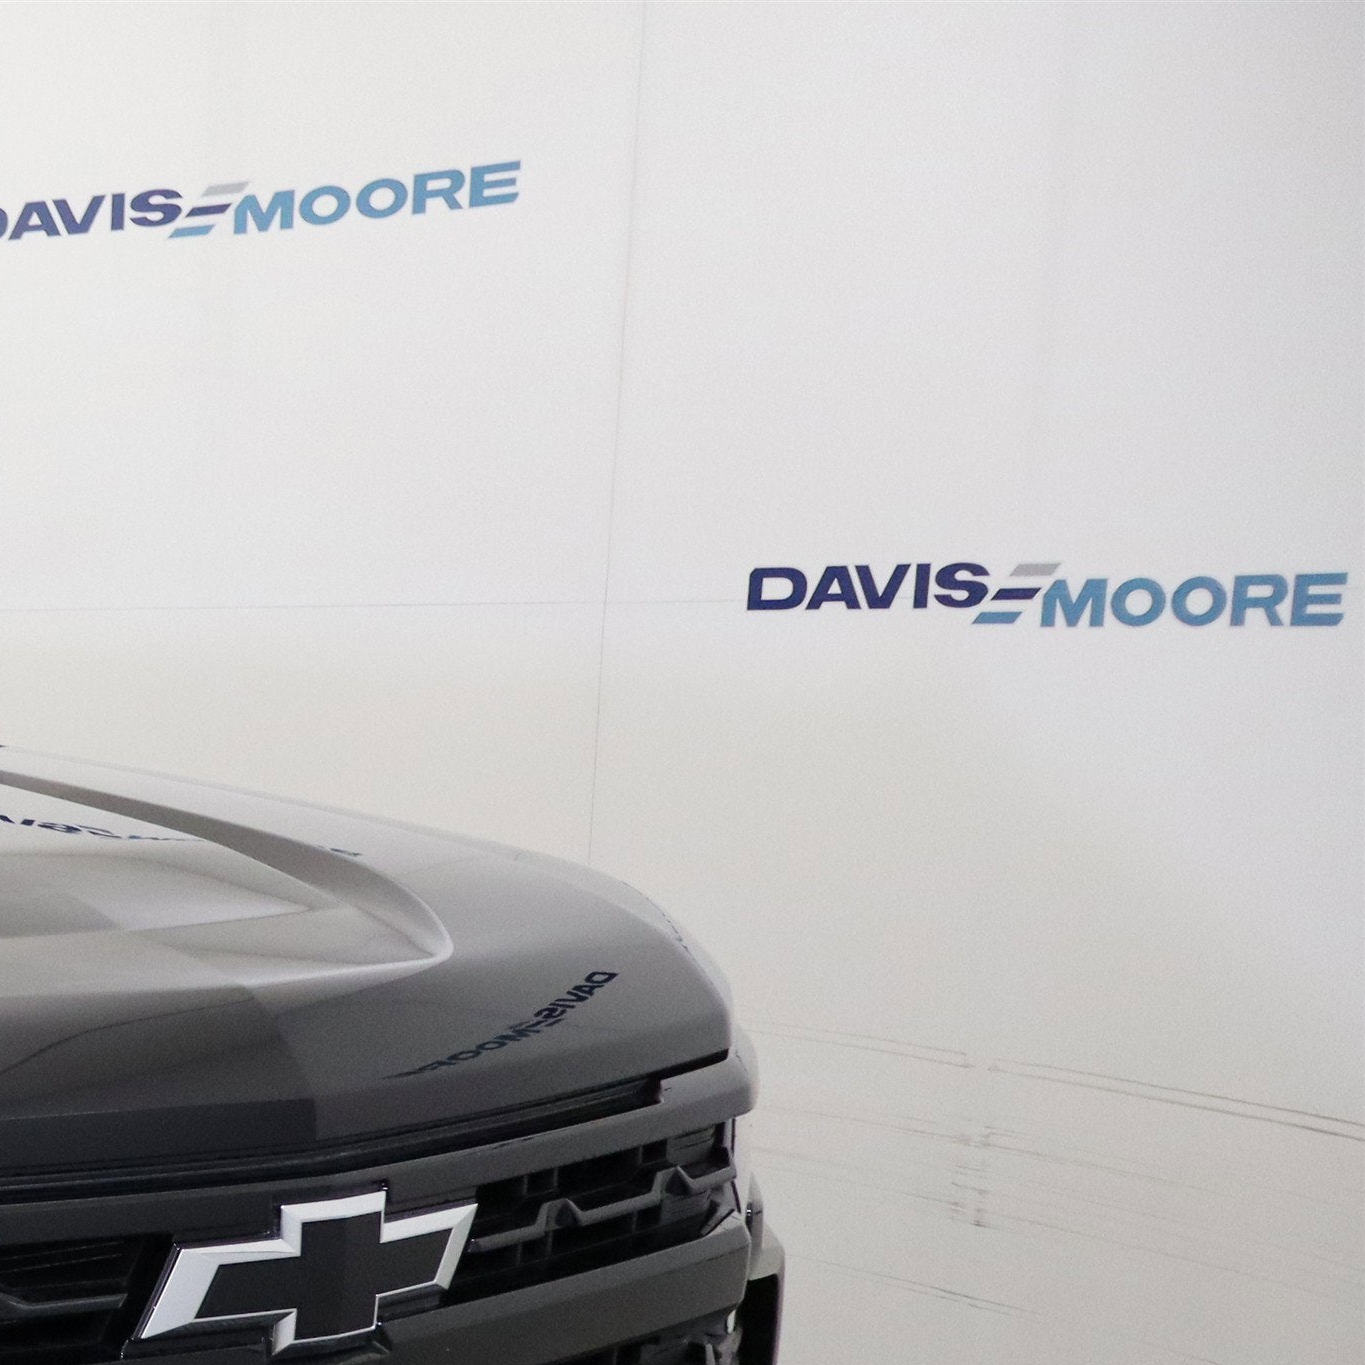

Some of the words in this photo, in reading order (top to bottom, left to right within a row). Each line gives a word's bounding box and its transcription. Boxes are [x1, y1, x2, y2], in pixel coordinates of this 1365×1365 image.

[232, 160, 521, 236] MOORE
[746, 561, 990, 612] DAVIS
[1039, 571, 1348, 628] MOORE
